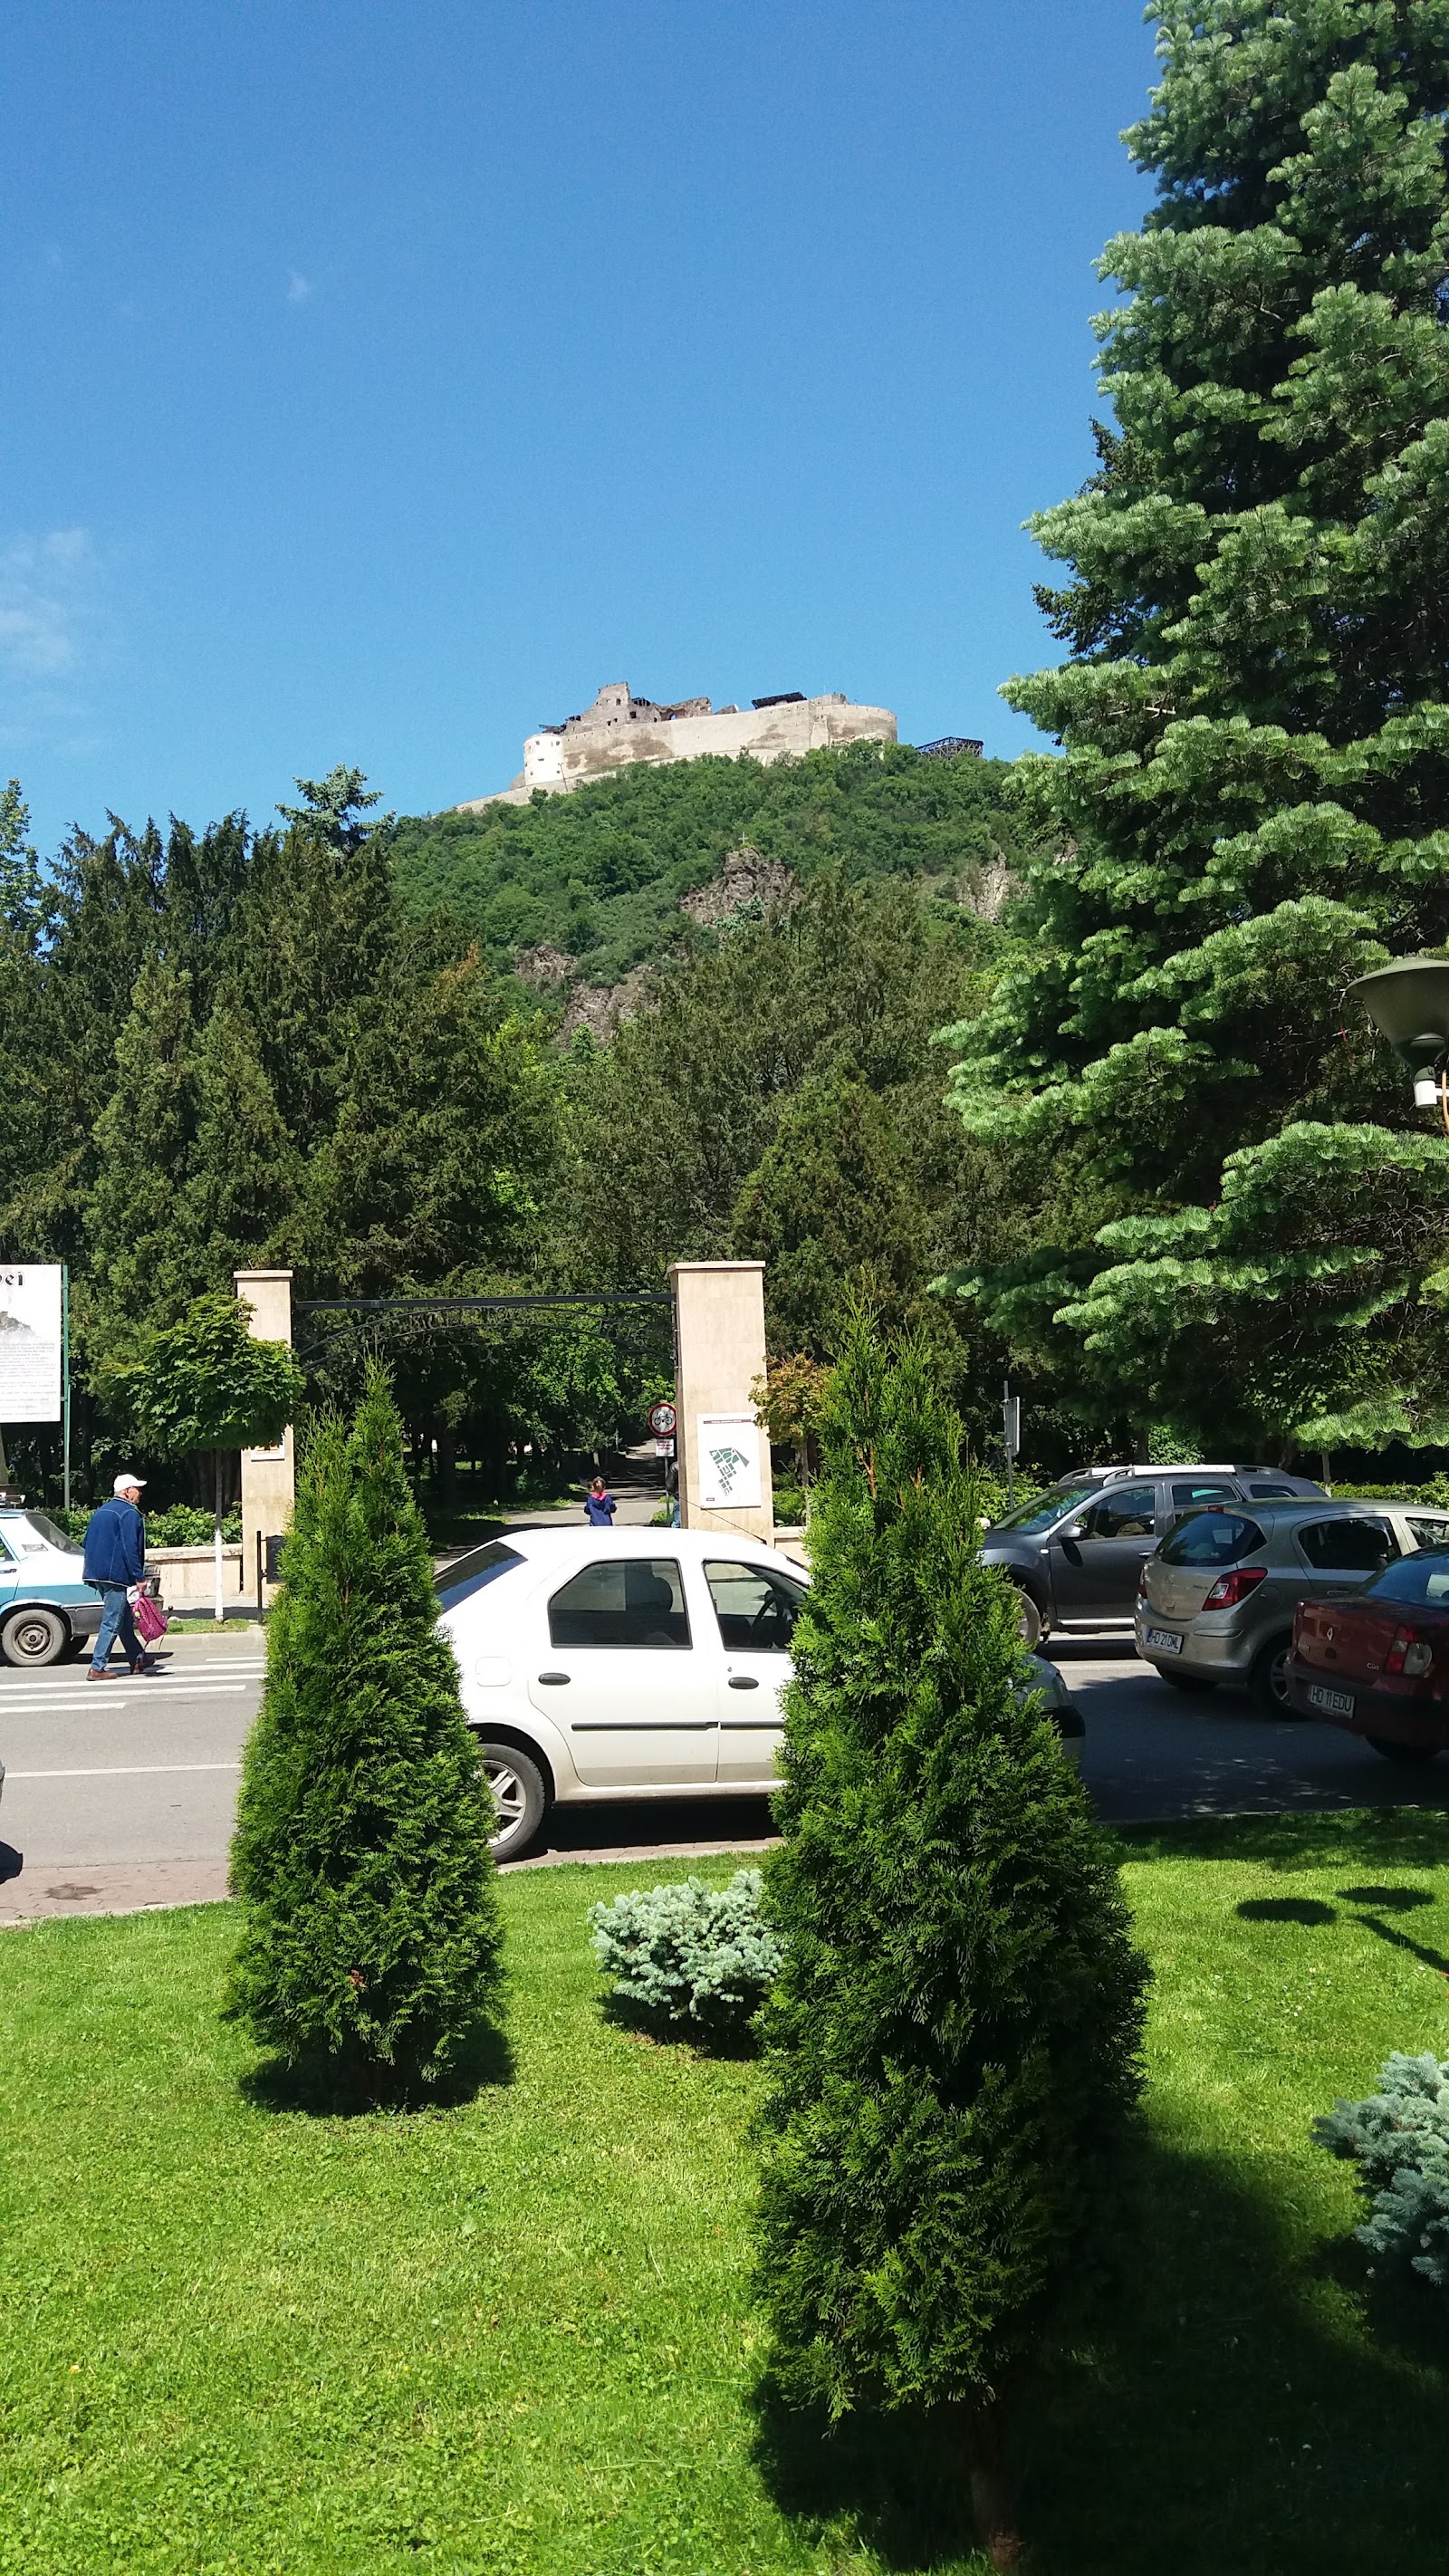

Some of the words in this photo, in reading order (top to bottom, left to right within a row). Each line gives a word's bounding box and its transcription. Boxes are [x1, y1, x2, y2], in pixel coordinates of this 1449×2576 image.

[0, 1271, 24, 1286] ei
[1311, 1687, 1323, 1703] HD
[1326, 1690, 1332, 1706] 11
[1332, 1693, 1352, 1712] EDU
